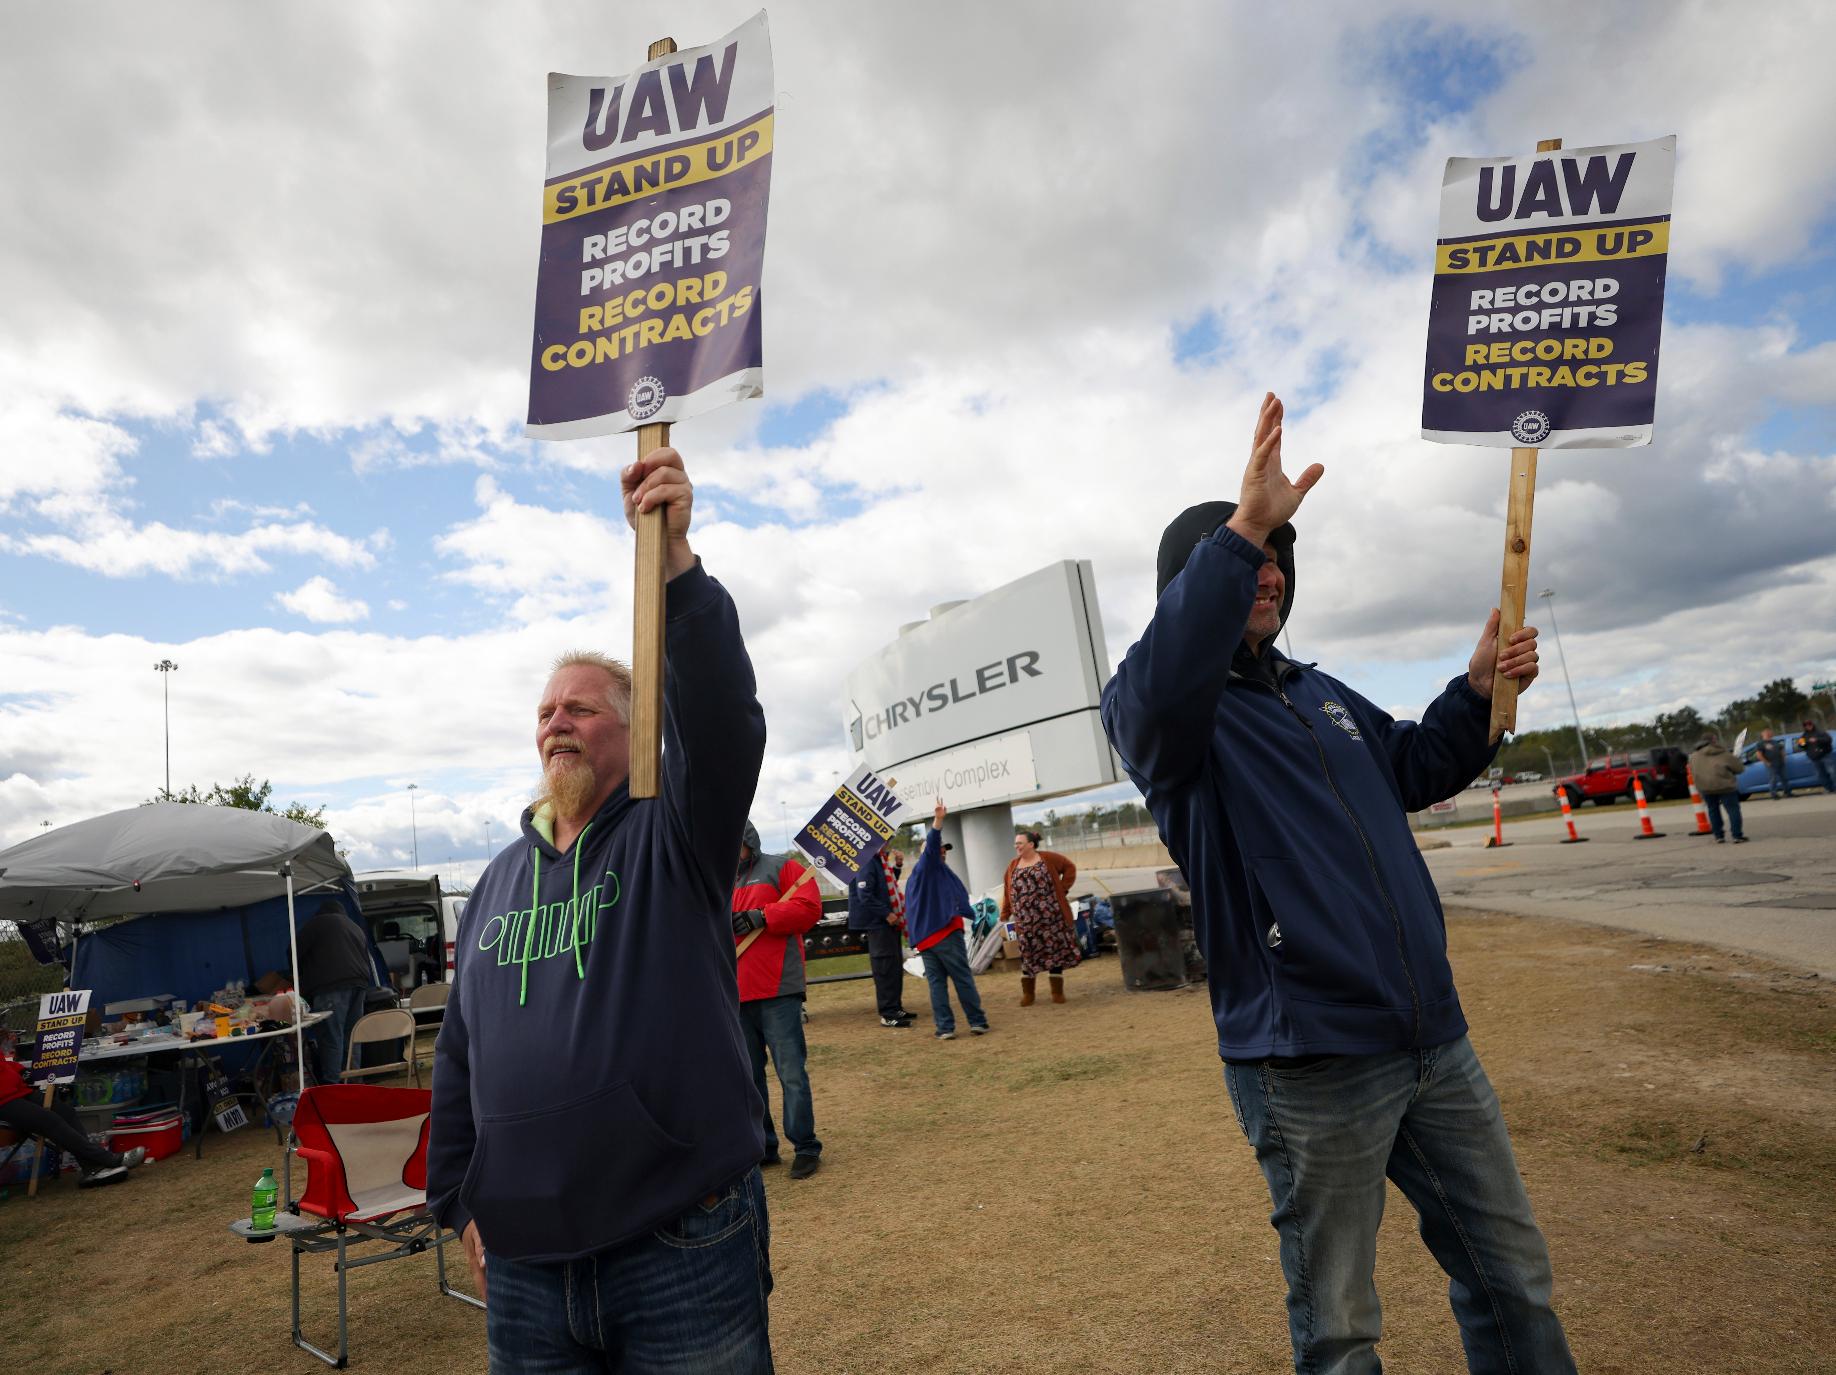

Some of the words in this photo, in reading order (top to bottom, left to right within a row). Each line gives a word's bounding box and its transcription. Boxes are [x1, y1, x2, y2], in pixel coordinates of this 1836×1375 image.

[582, 41, 738, 151] UAW
[555, 154, 691, 215] STAND
[706, 130, 759, 172] UP
[1476, 152, 1636, 223] UAW
[582, 198, 731, 263] RECORD
[580, 230, 730, 296] PROFITS
[1447, 237, 1582, 270] STAND
[1596, 229, 1654, 256] UP
[579, 271, 728, 334] RECORD
[1470, 278, 1620, 311] RECORD
[541, 285, 753, 372] CONTRACTS
[1467, 304, 1618, 335] PROFITS
[1464, 337, 1614, 366] RECORD
[1432, 361, 1648, 393] CONTRACTS
[1523, 422, 1540, 430] UAW
[864, 650, 1044, 740] CHRYSLER
[944, 759, 1011, 790] Complex
[838, 790, 873, 822] STAND
[873, 820, 889, 834] UP
[856, 772, 903, 818] UAW
[820, 823, 858, 858] RECORD
[827, 815, 866, 850] PROFITS
[833, 807, 872, 842] RECORD
[806, 824, 860, 872] CONTRACTS
[49, 993, 83, 1015] UAW
[40, 1018, 69, 1030] STAND
[71, 1016, 84, 1026] UP
[43, 1030, 76, 1042] RECORD
[33, 1055, 78, 1070] CONTRACTS
[41, 1048, 73, 1060] RECORD
[42, 1039, 74, 1051] PROFITS
